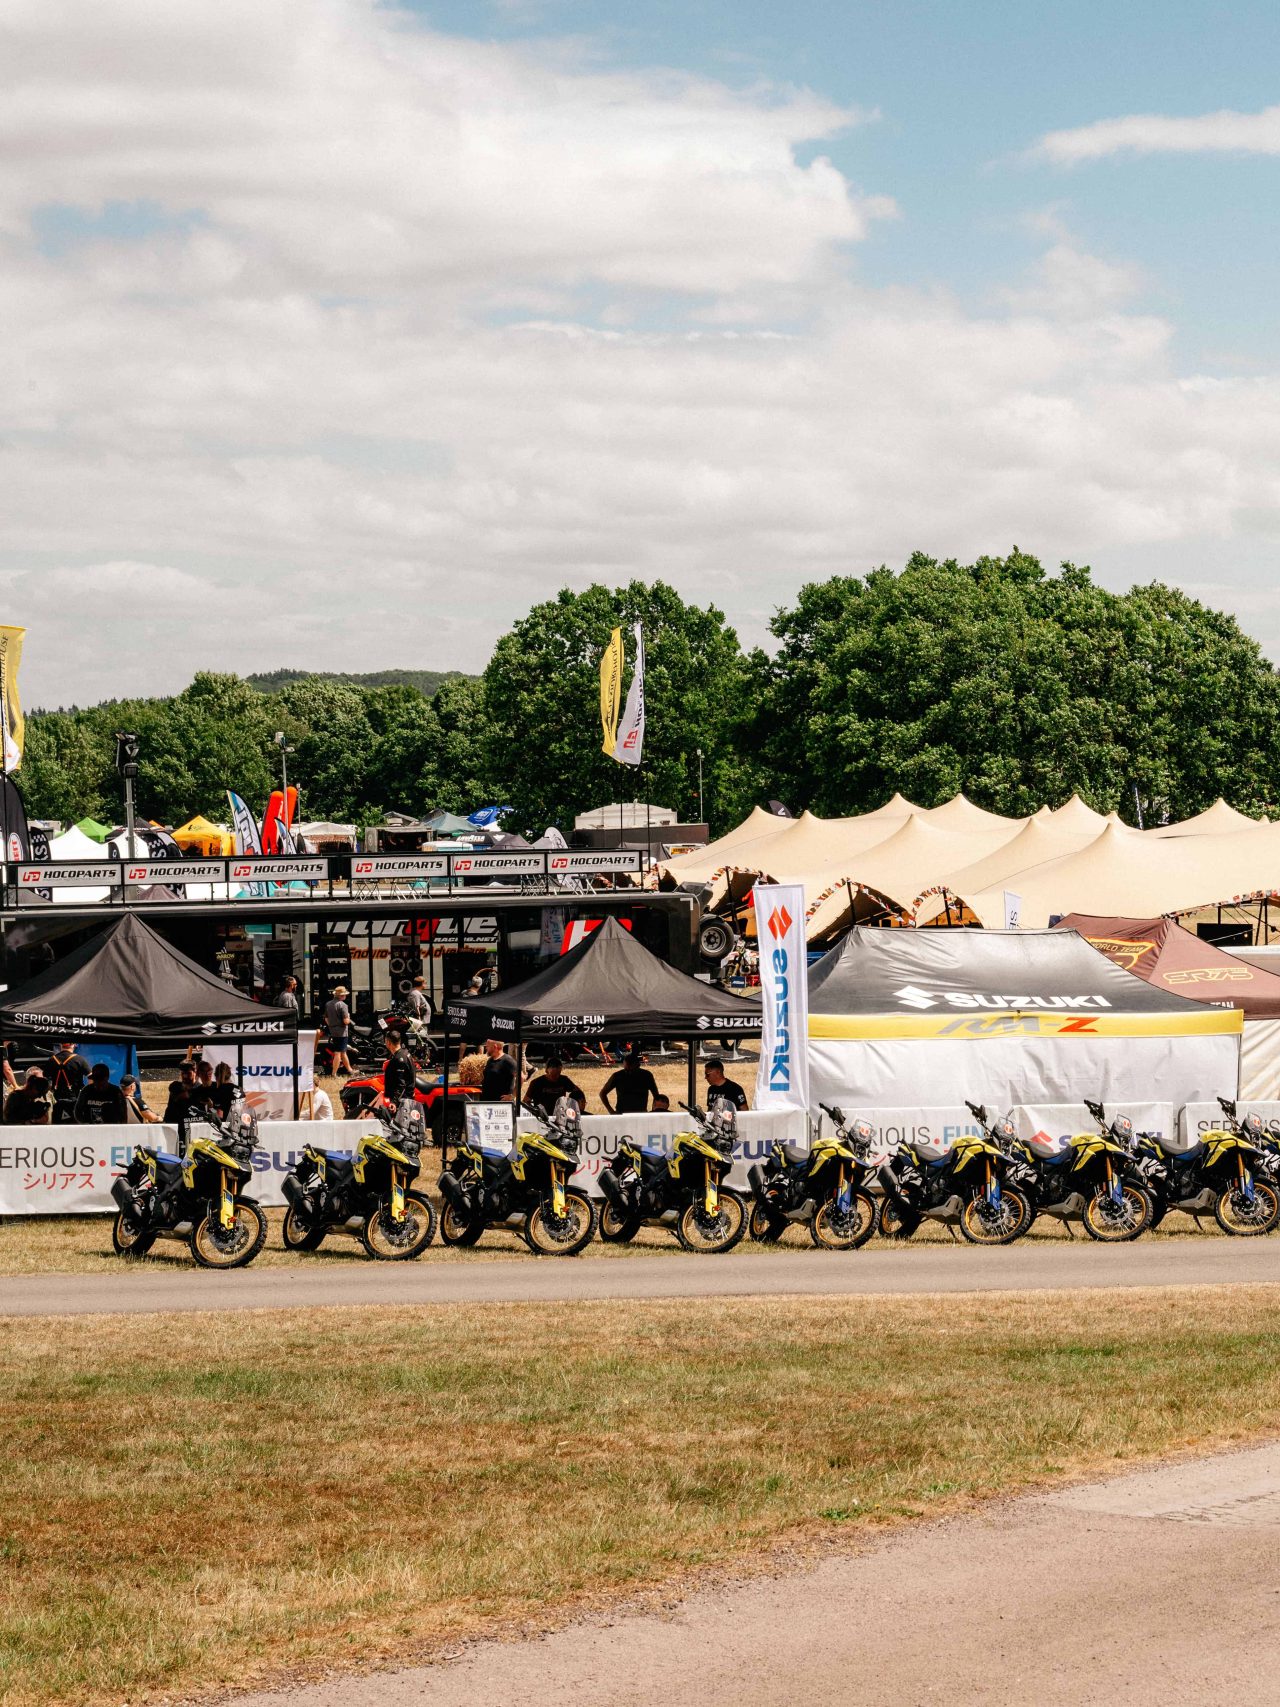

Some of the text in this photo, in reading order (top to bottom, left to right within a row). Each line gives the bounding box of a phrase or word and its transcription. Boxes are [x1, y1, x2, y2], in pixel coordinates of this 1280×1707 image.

[375, 860, 443, 870] HOCOPARTS
[474, 858, 541, 867] HOCOPARTS
[570, 856, 635, 865] HOCOPARTS
[44, 869, 117, 878] HOCOPARTS
[150, 866, 220, 876] HOCOPARTS
[254, 864, 324, 873] HOCOPARTS
[1121, 945, 1145, 953] TEAM
[944, 992, 1113, 1008] SUZUKI
[14, 1013, 97, 1029] SERIOUS.FUN
[532, 1015, 605, 1026] SERIOUS.FUN
[713, 1017, 764, 1027] SUZUK
[937, 1016, 1101, 1034] RM-Z
[220, 1021, 285, 1034] SUZUKI
[24, 1173, 95, 1190] シリアス
